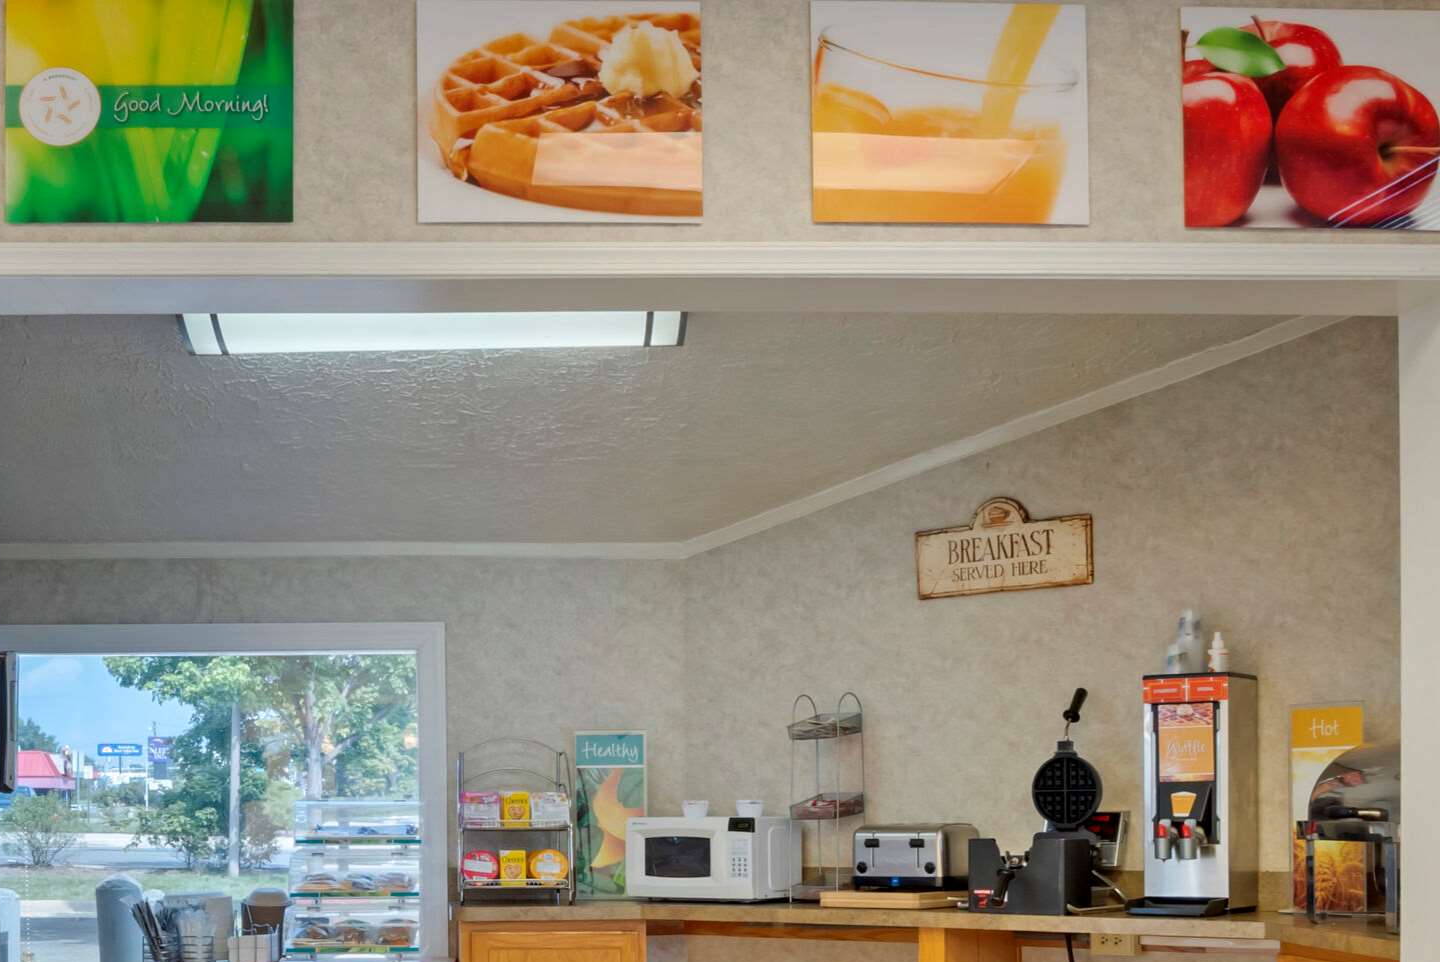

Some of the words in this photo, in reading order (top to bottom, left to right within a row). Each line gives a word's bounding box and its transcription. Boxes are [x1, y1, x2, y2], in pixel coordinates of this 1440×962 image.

[114, 91, 162, 122] Good
[167, 91, 269, 121] Morning!
[947, 528, 1055, 565] BREAKFAST
[951, 563, 1005, 583] SERVED
[1011, 559, 1049, 577] HERE
[1309, 717, 1341, 739] Hot
[581, 741, 639, 764] Healthy
